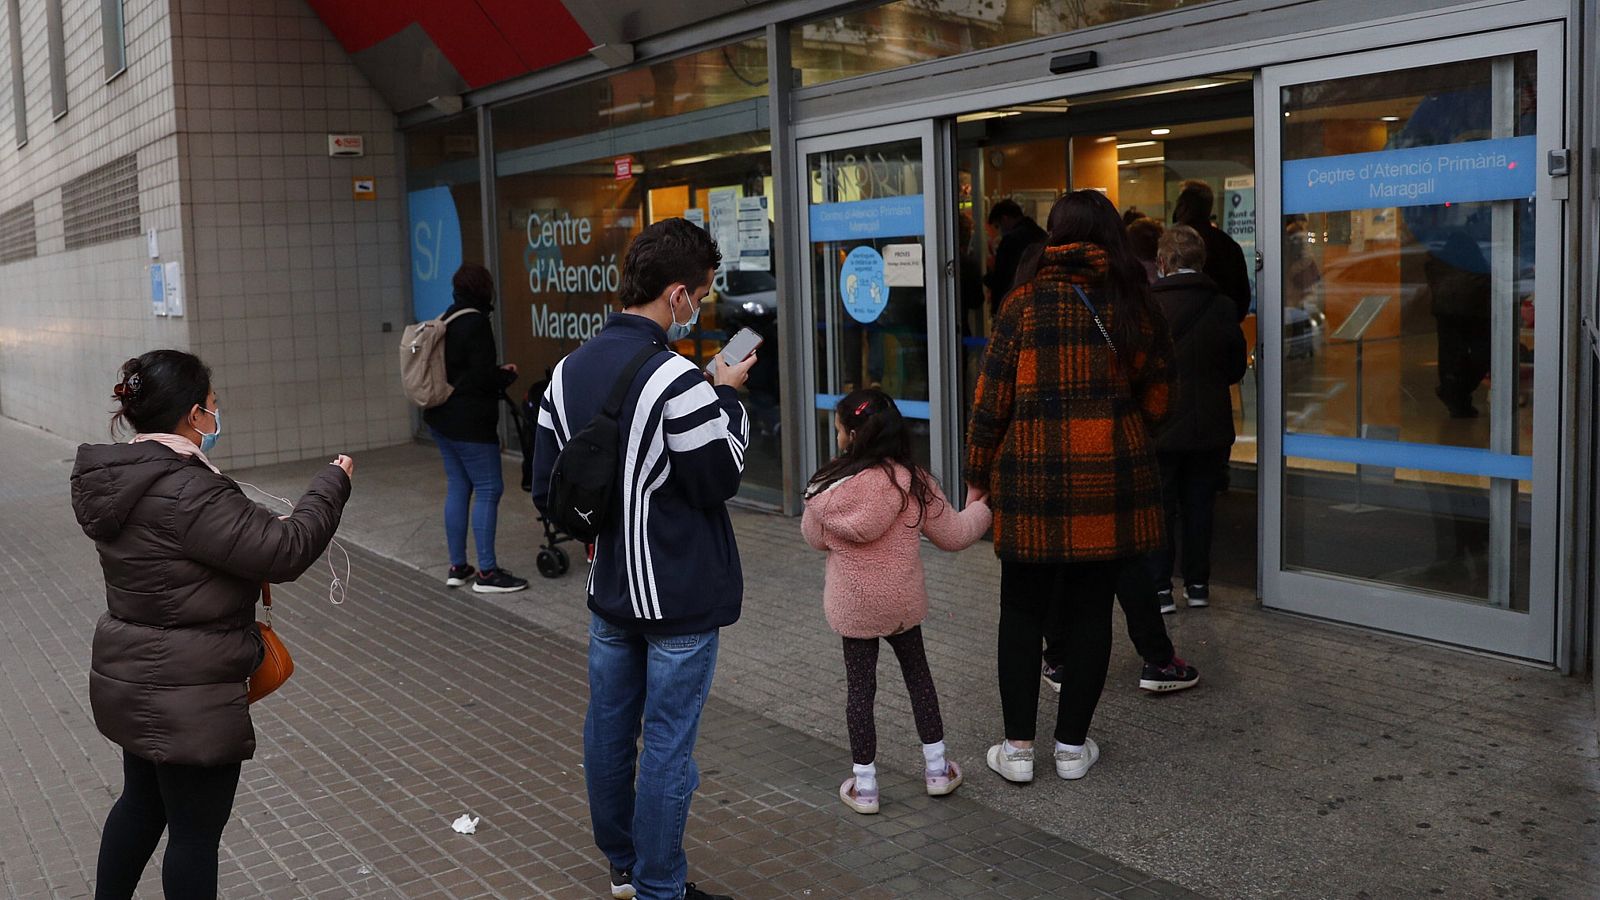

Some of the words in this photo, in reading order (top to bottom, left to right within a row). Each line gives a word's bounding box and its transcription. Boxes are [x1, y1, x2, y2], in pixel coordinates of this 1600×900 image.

[1307, 169, 1355, 186] Centre
[1359, 160, 1433, 179] d'Atenció
[1437, 152, 1507, 173] Primària
[1369, 179, 1435, 199] Maragall
[527, 213, 591, 248] Centre
[529, 254, 620, 293] d'Atenció
[531, 304, 613, 346] Maragal
